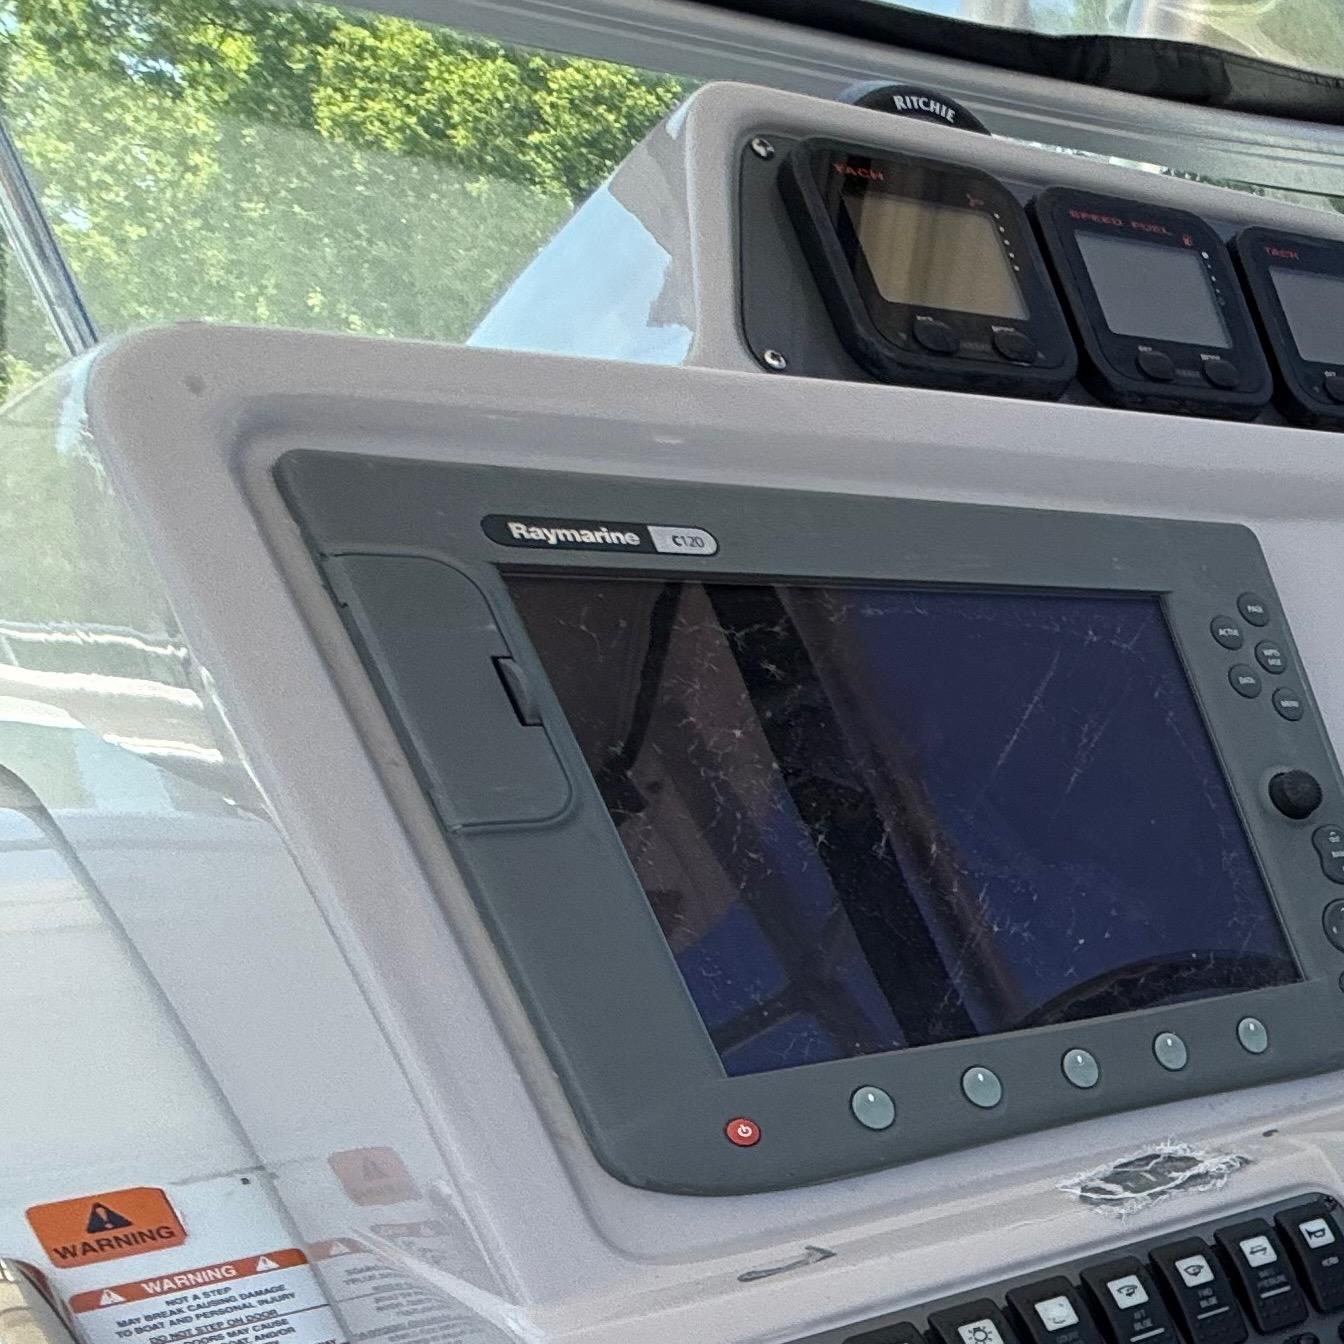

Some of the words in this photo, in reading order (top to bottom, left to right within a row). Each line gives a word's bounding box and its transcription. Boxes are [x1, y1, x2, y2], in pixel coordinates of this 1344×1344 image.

[892, 94, 956, 124] RITCHIE
[507, 521, 641, 545] Raymarine
[53, 1225, 176, 1260] WARNING
[139, 1263, 238, 1294] WARNING
[115, 1316, 142, 1328] MAY
[143, 1307, 186, 1321] BREAK
[185, 1295, 238, 1312] CAUSING
[237, 1284, 287, 1300] DAMAGE
[164, 1295, 191, 1306] NOT
[191, 1292, 201, 1300] A
[201, 1286, 233, 1298] STEP
[115, 1328, 133, 1338] TO
[133, 1321, 166, 1334] BOAT
[167, 1315, 194, 1326] AND
[193, 1301, 256, 1320] PERSONAL
[256, 1292, 296, 1305] INJURY
[148, 1334, 168, 1344] DO
[168, 1328, 195, 1340] NOT
[195, 1321, 225, 1334] STEP
[225, 1316, 244, 1327] ON
[244, 1308, 279, 1322] DOOR
[226, 1326, 250, 1338] MAY
[251, 1317, 289, 1332] CAUSE
[252, 1326, 296, 1341] AND/OR
